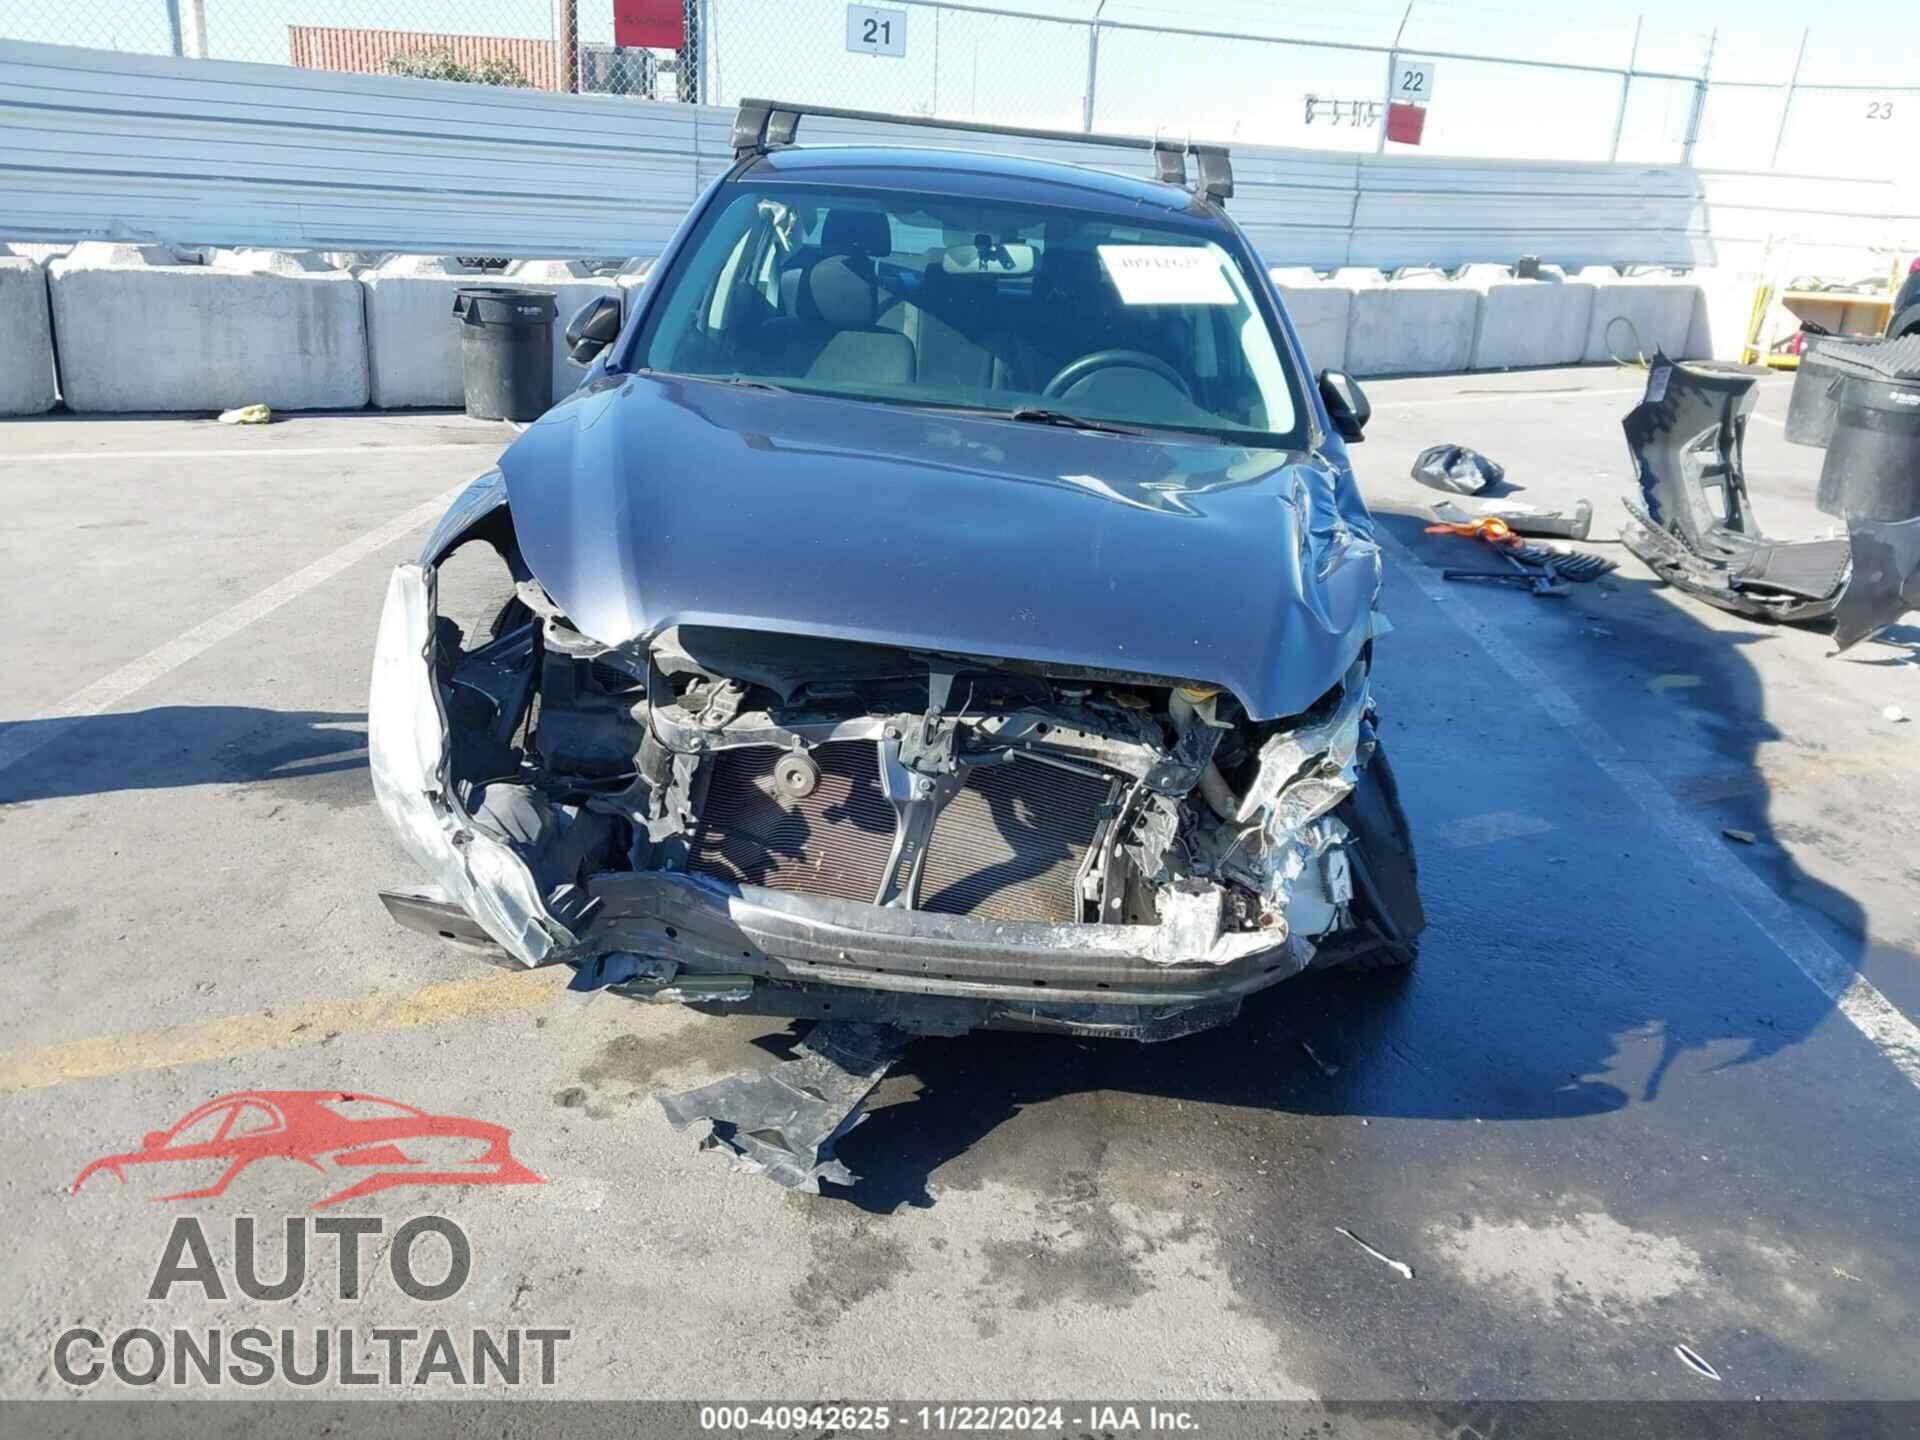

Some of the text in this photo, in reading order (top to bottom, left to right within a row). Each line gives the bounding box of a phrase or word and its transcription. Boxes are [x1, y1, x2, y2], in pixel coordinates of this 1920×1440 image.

[863, 19, 890, 44] 21
[1403, 72, 1424, 91] 22
[1867, 102, 1894, 119] 23
